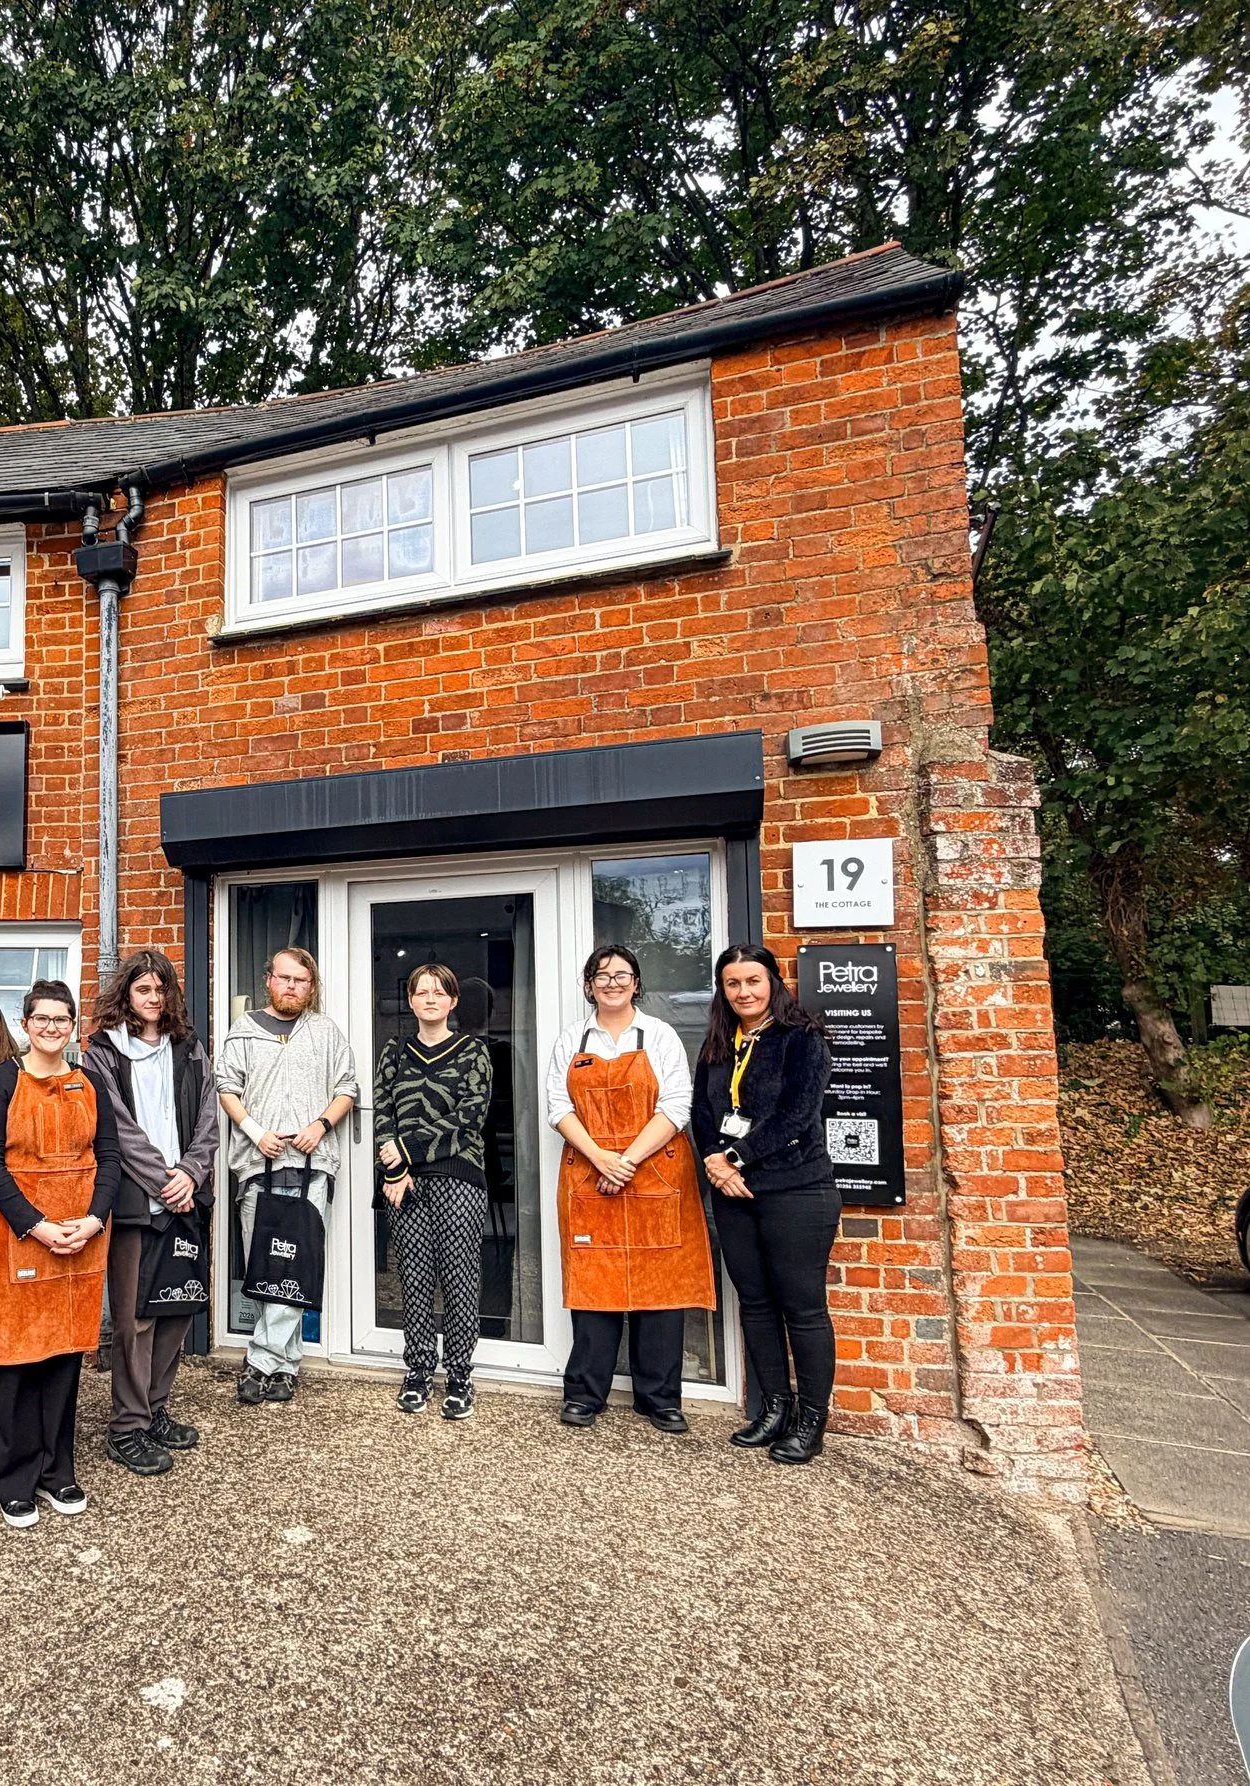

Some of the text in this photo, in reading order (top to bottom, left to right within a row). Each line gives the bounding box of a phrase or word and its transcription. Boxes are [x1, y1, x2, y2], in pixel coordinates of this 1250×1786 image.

[819, 857, 865, 891] 19
[815, 900, 872, 909] THE COTTAGE
[819, 961, 878, 982] Petra
[816, 980, 878, 995] Jewellery
[824, 1009, 872, 1017] VISITING US
[175, 1236, 199, 1255] Petra
[271, 1237, 297, 1254] Petra
